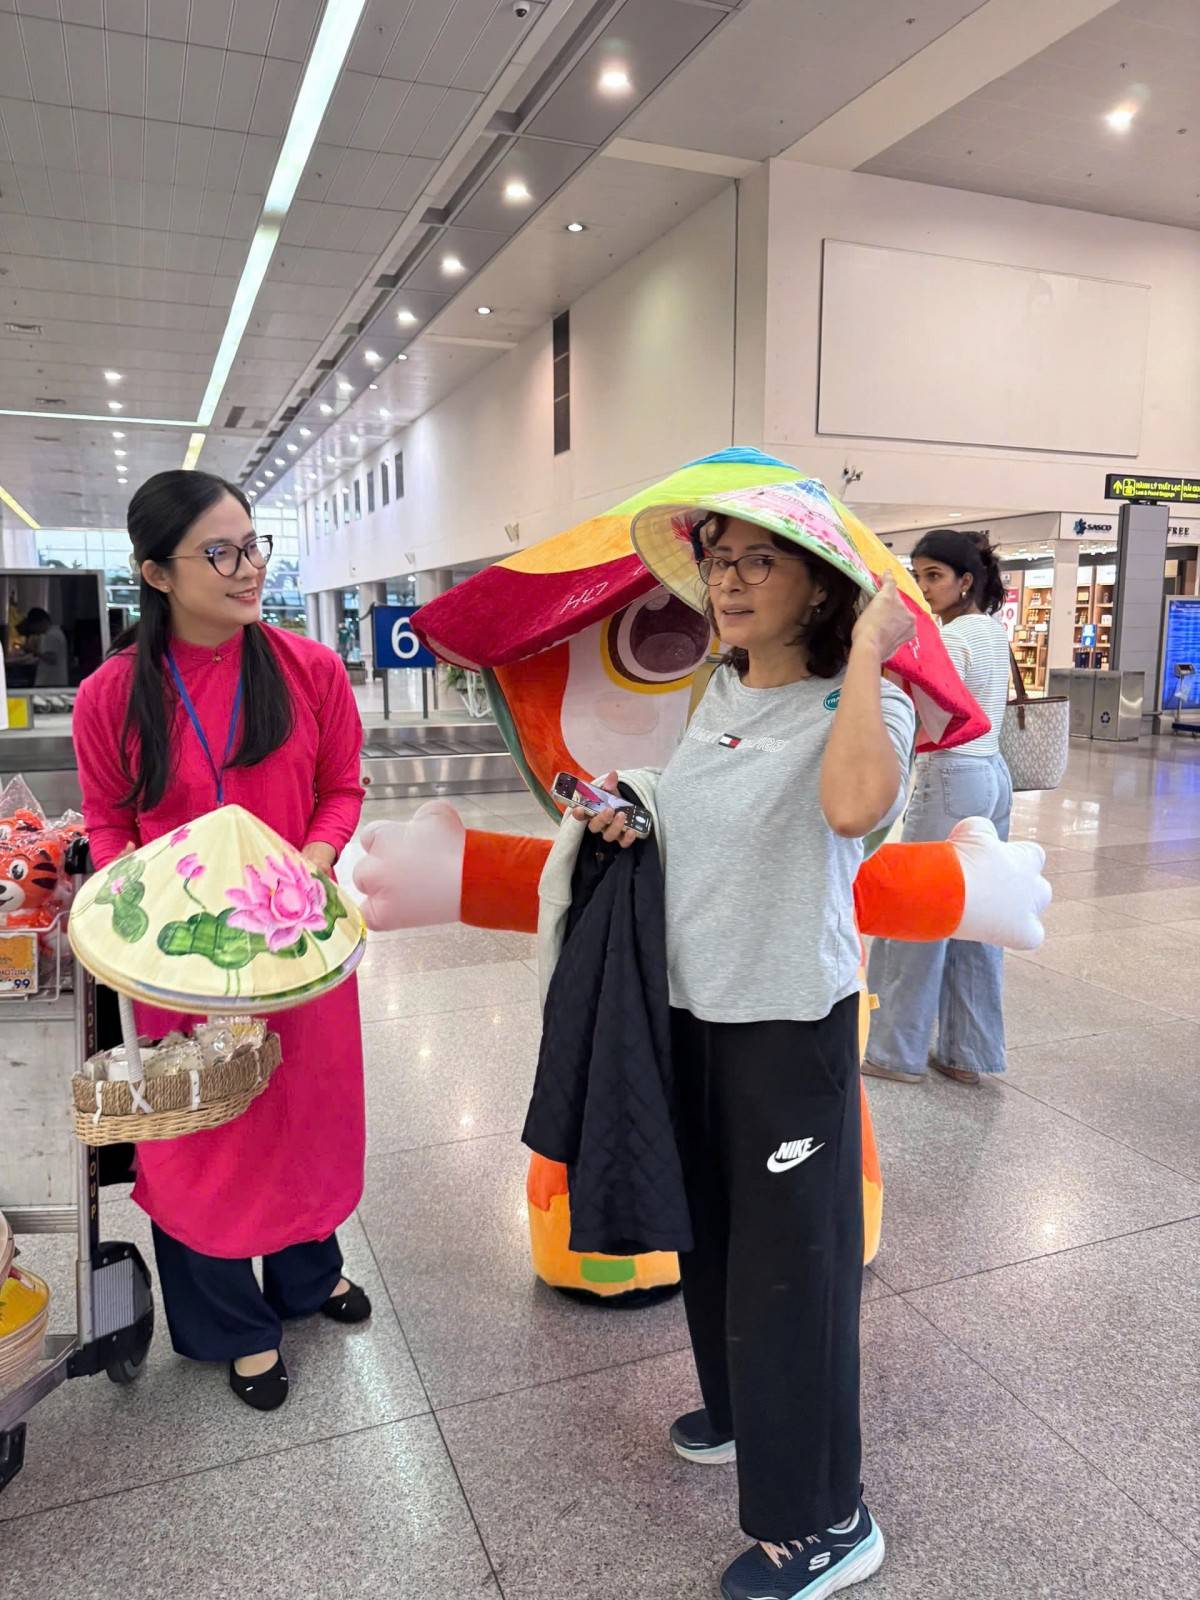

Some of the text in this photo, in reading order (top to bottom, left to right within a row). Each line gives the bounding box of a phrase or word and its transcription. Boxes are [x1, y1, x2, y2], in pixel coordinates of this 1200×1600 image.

[1168, 526, 1190, 536] FREE
[391, 616, 420, 659] 6
[775, 1136, 814, 1159] NIKE
